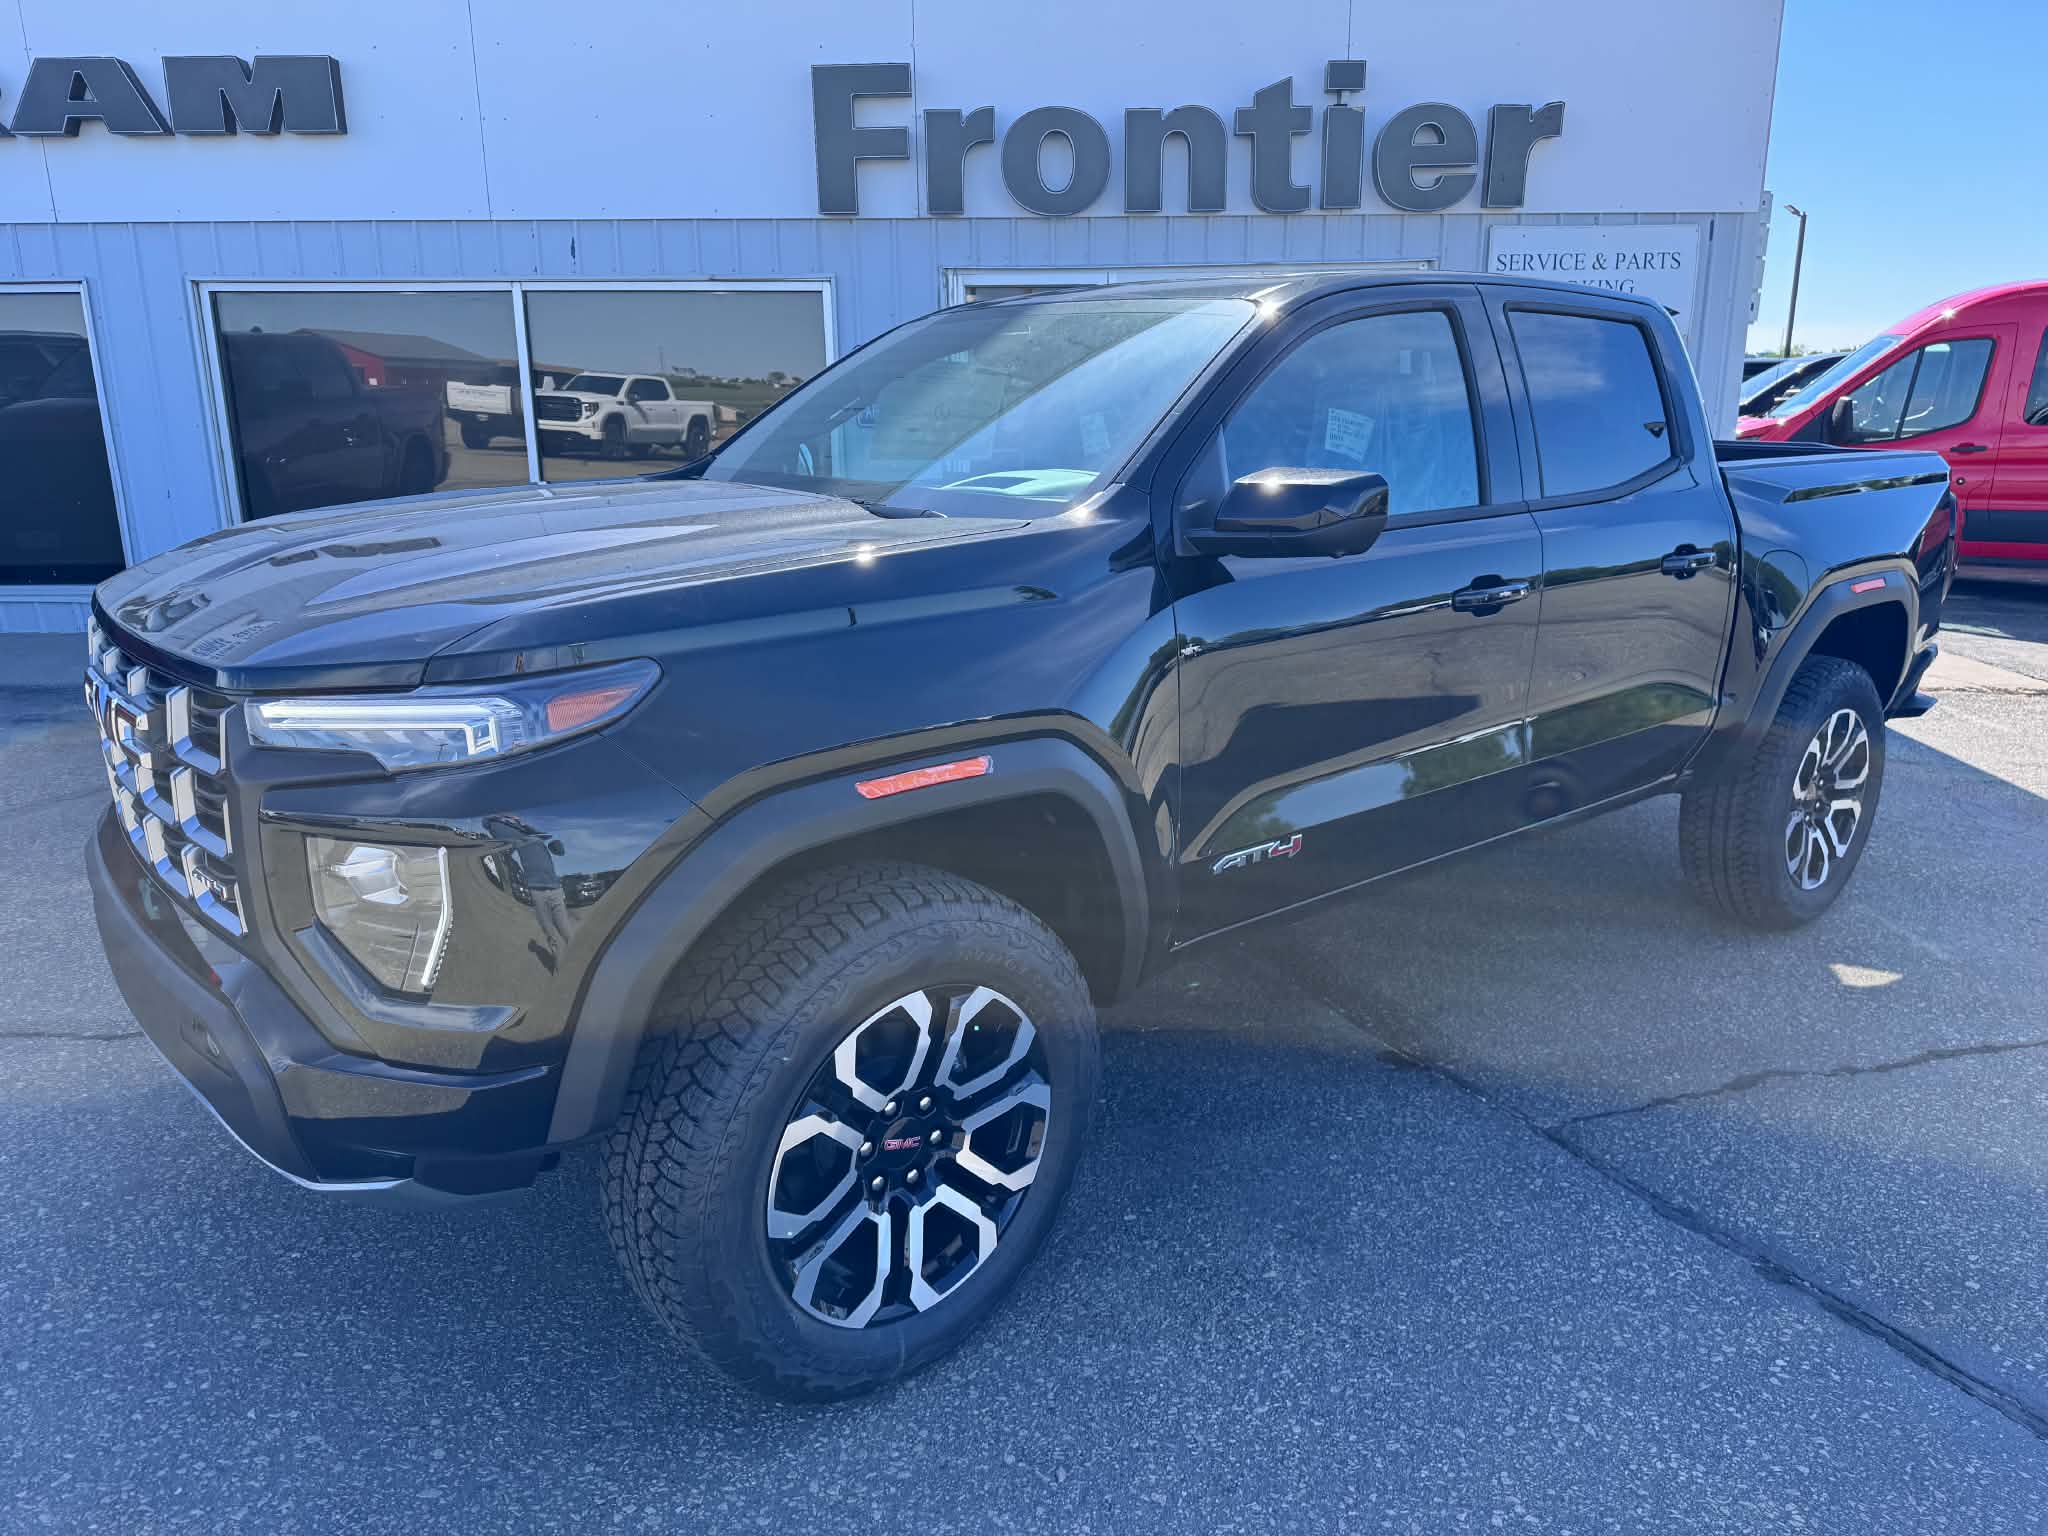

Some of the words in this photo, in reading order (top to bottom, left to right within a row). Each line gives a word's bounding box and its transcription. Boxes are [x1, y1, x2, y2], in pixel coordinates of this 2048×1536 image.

[0, 55, 347, 137] AM
[810, 59, 1567, 215] Frontier
[1496, 252, 1586, 272] SERVICE
[1592, 252, 1608, 271] &
[1615, 250, 1681, 270] PARTS
[1212, 833, 1303, 875] AT4
[883, 1135, 921, 1151] GMC
